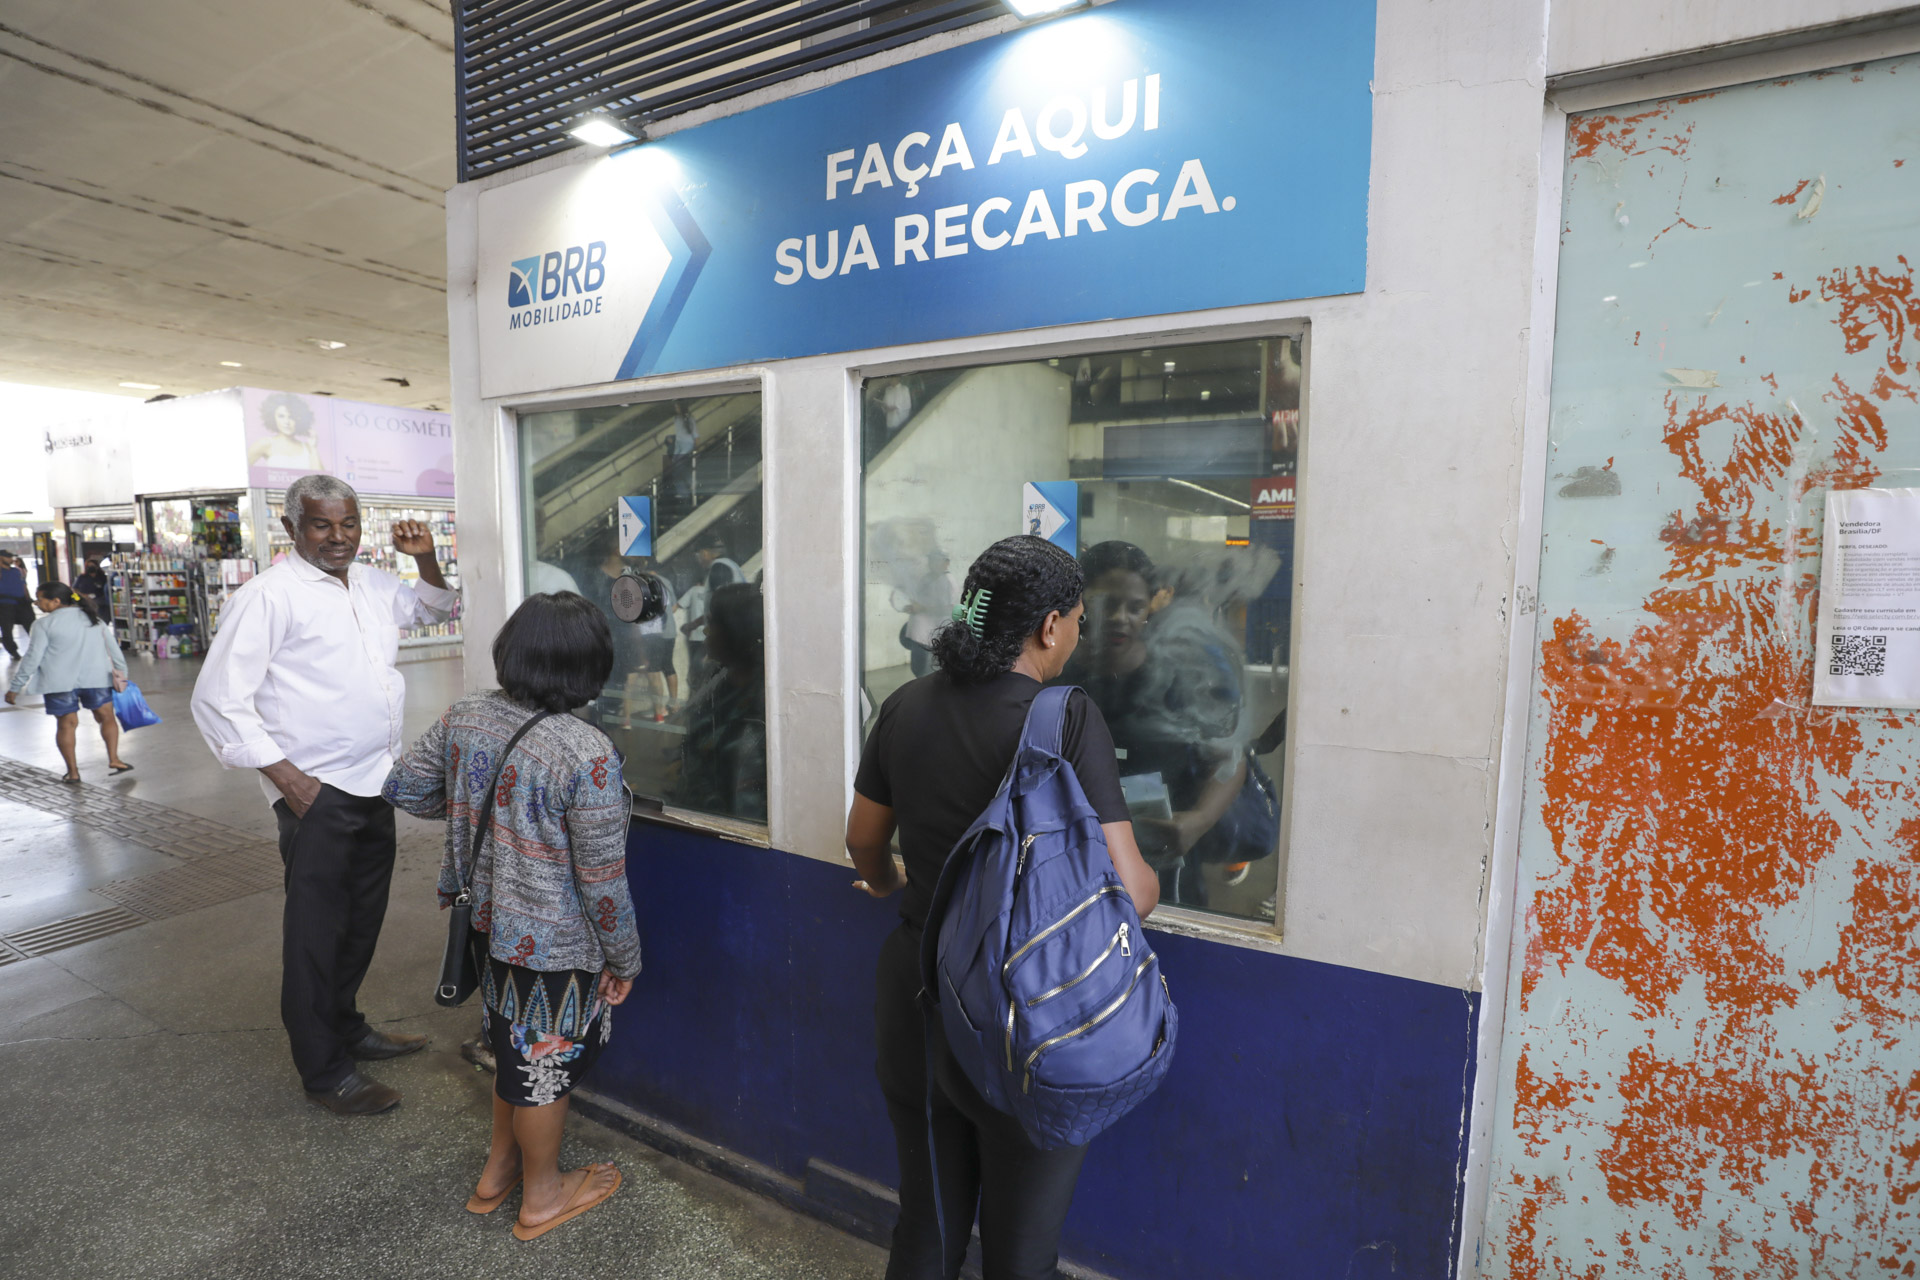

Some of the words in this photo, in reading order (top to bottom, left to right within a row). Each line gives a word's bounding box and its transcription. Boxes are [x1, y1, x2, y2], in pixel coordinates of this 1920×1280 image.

[826, 122, 975, 200] FAÇA
[987, 73, 1160, 160] AQUI
[773, 224, 880, 286] SUA
[894, 158, 1237, 266] RECARGA.
[541, 240, 606, 301] BRB
[509, 296, 603, 330] MOBILIDADE
[343, 409, 369, 429] SÓ
[622, 524, 628, 537] 1
[1029, 518, 1042, 536] 2
